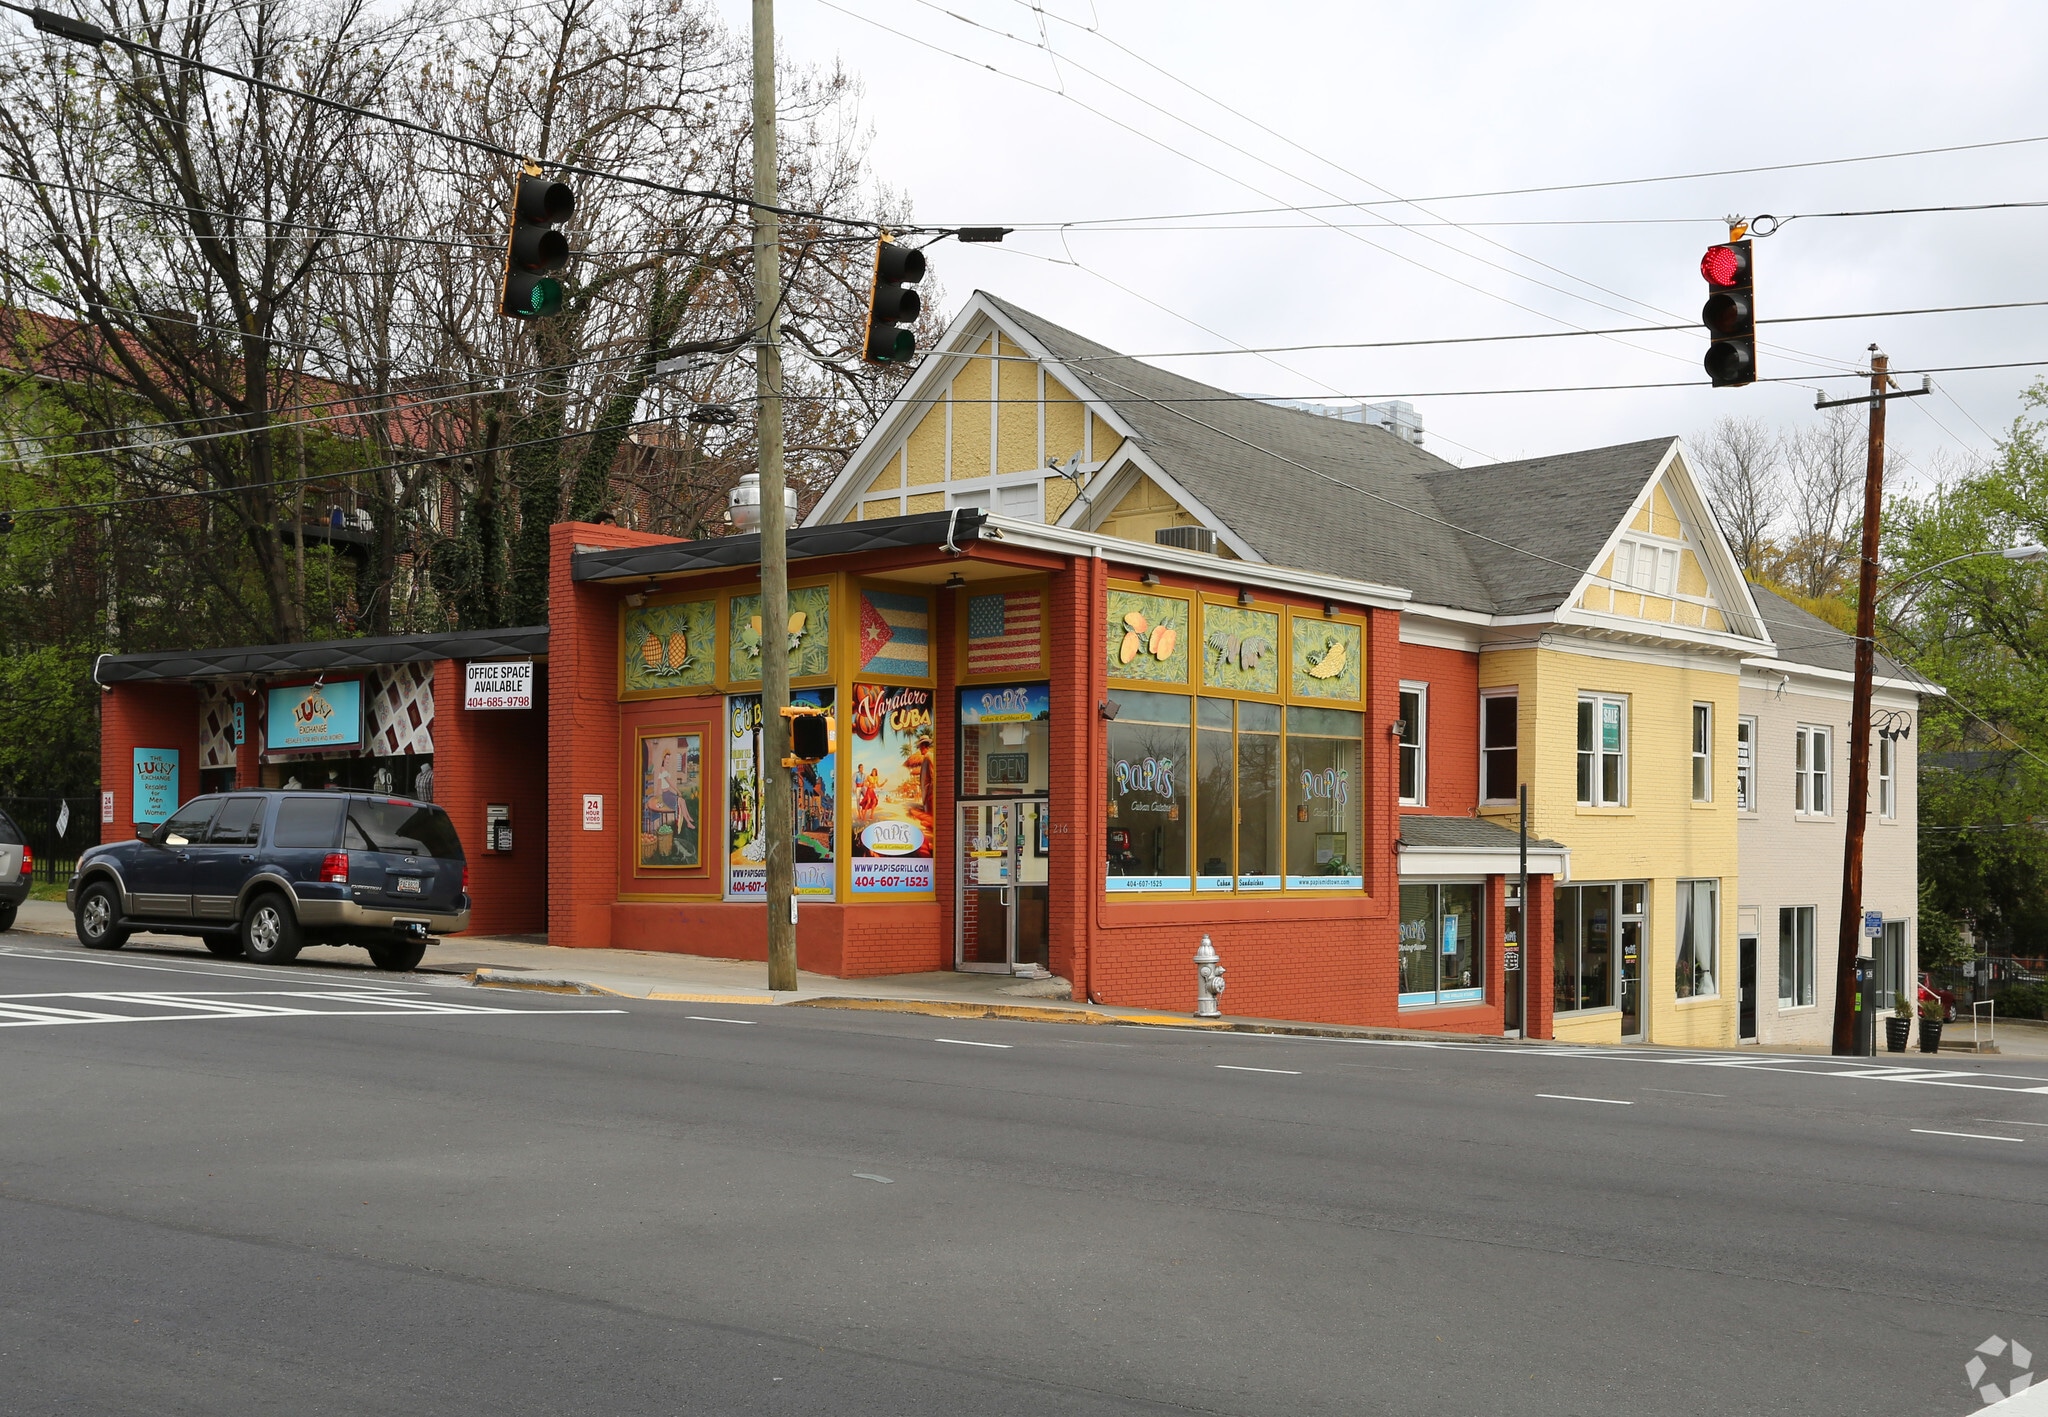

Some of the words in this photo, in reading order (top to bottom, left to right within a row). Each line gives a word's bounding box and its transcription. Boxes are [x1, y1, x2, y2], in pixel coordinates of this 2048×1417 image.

[468, 667, 499, 679] OFFICE
[500, 666, 530, 678] SPACE
[474, 680, 523, 692] AVAILABLE
[467, 696, 530, 707] 404-685-9798
[858, 688, 929, 726] Varadero
[294, 697, 332, 722] LUCKY
[731, 703, 763, 738] CUB
[890, 708, 932, 730] CUBA
[1603, 709, 1618, 723] SALE
[299, 724, 327, 735] EXCHANGE
[136, 762, 176, 776] LUCKY
[990, 758, 1024, 779] OPEN
[144, 783, 168, 791] Resales
[587, 800, 599, 810] 24
[1131, 801, 1150, 811] Cuban
[1053, 824, 1068, 834] 216
[732, 881, 768, 892] 404-607-1
[854, 876, 929, 887] 404-607-1525
[1126, 880, 1163, 888] 404-607-1525
[1217, 879, 1231, 887] Cuban
[1238, 879, 1264, 887] Sandwiches
